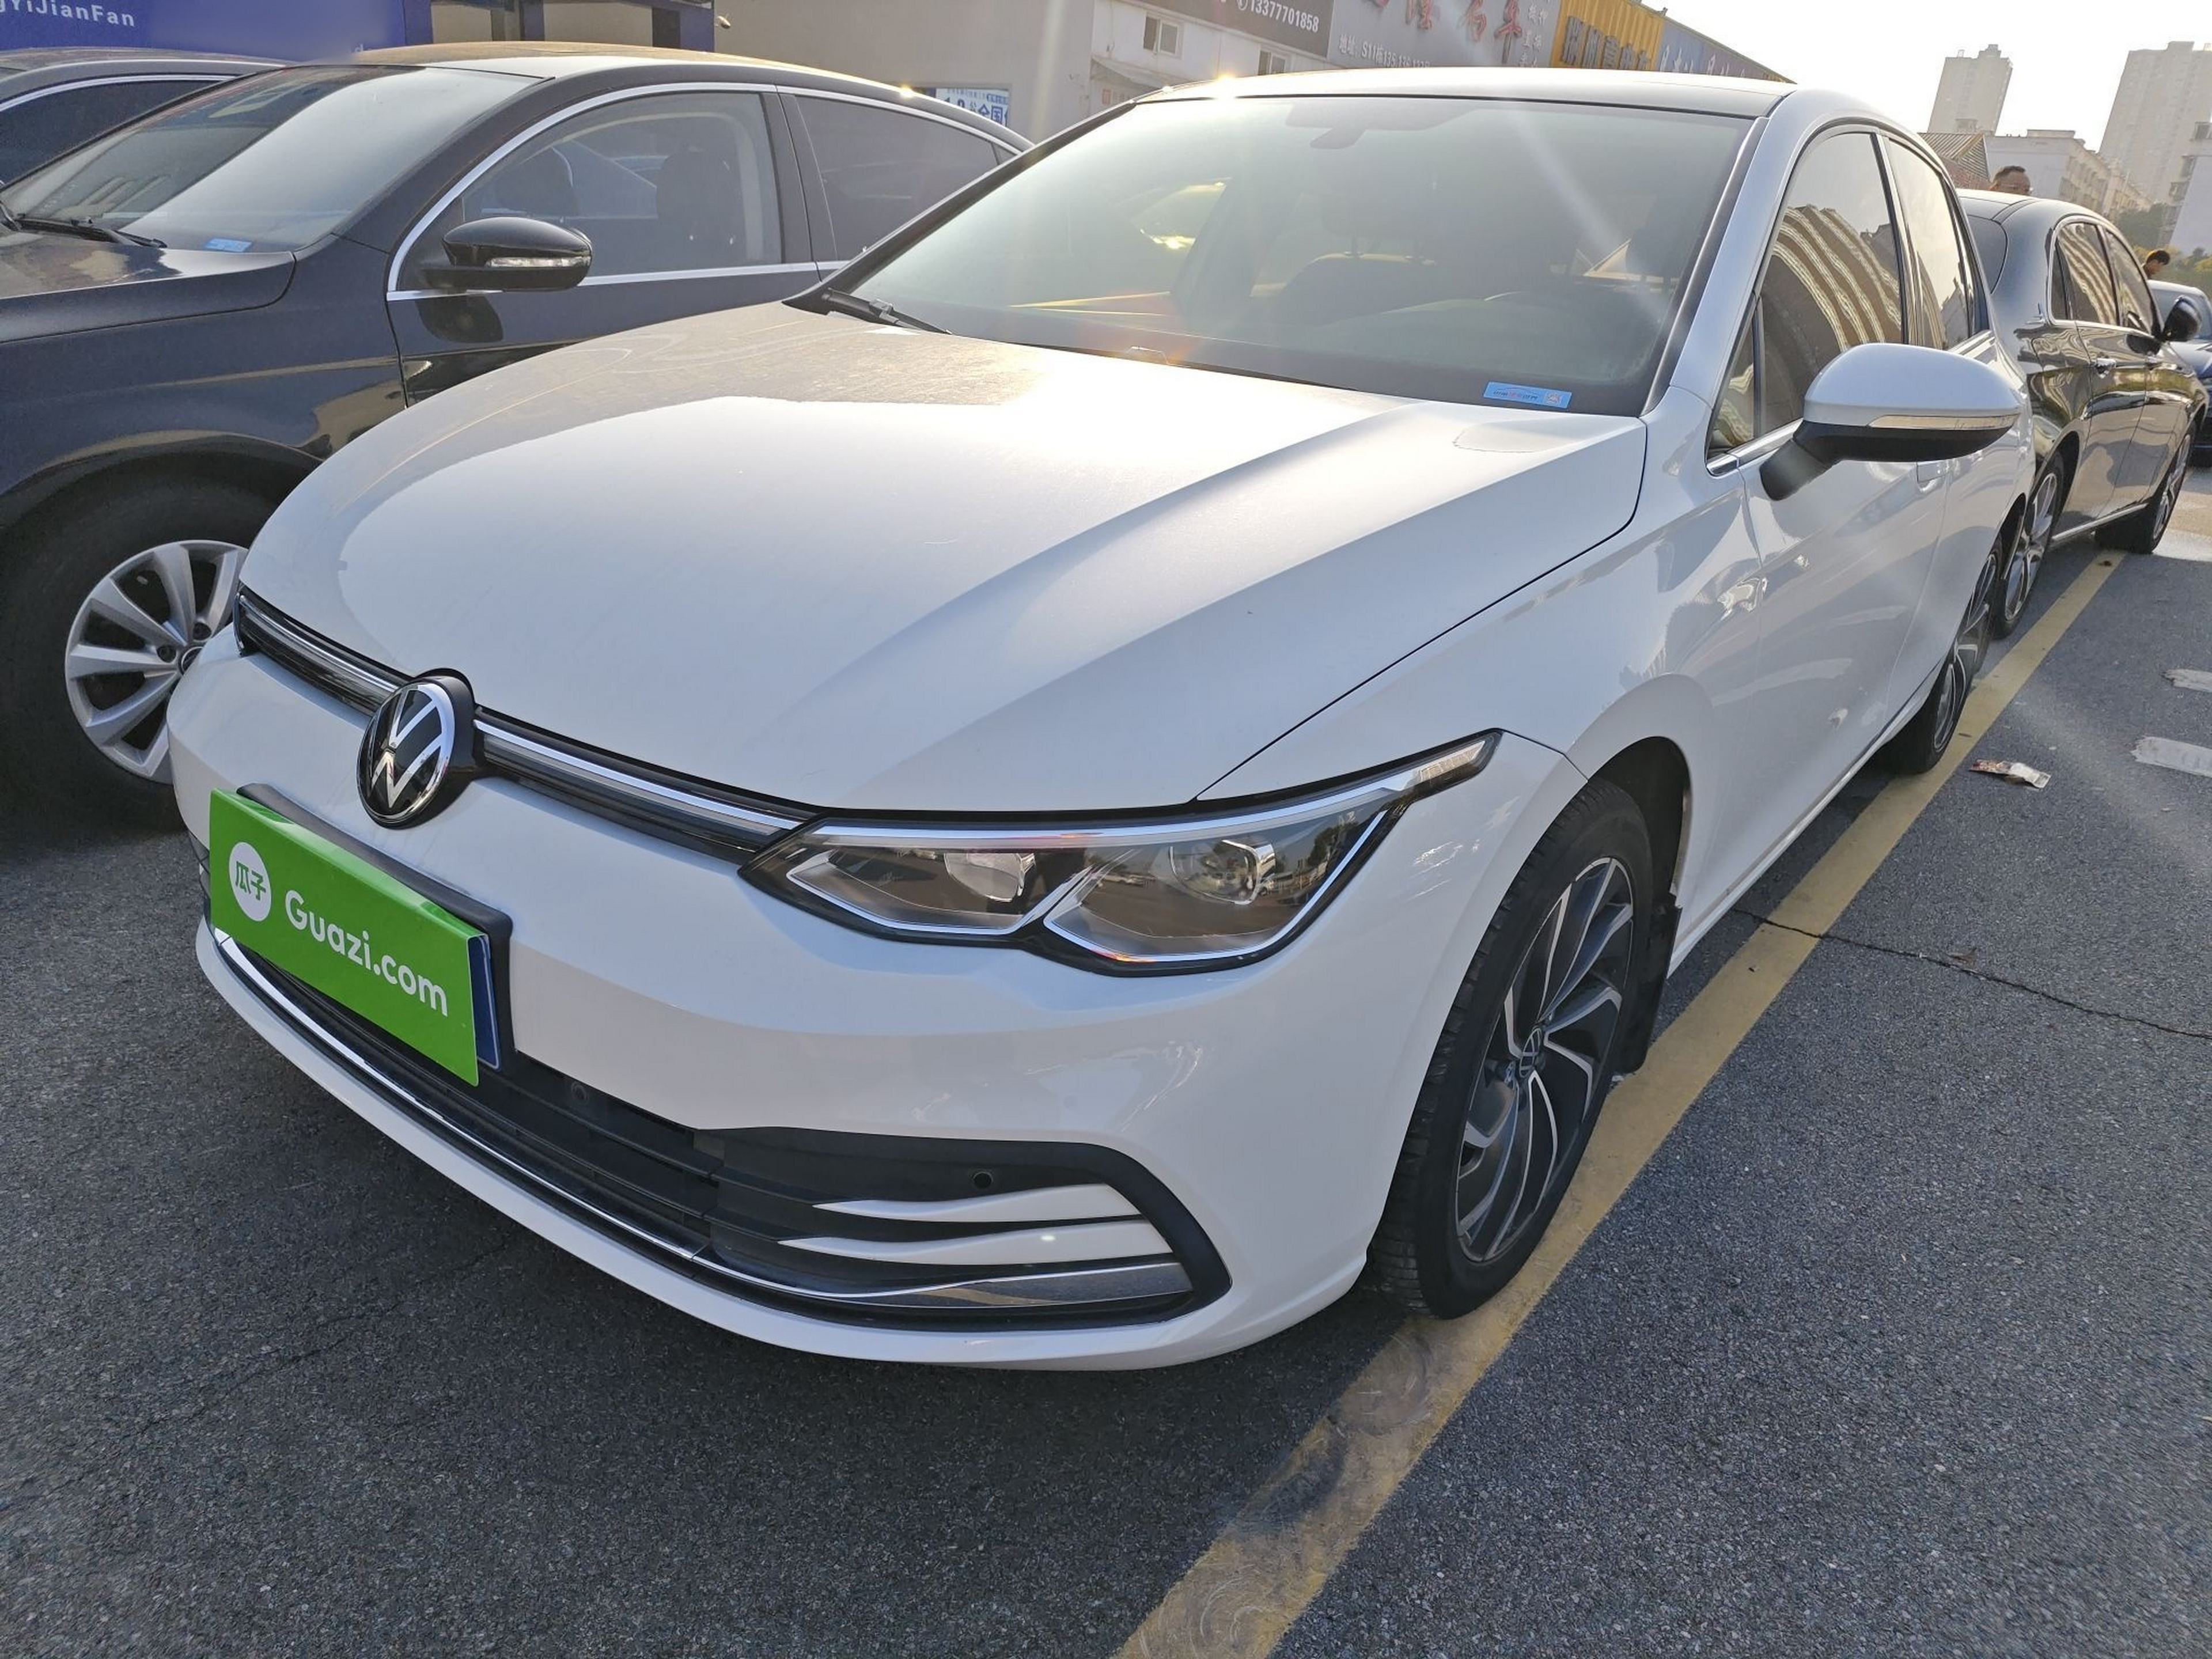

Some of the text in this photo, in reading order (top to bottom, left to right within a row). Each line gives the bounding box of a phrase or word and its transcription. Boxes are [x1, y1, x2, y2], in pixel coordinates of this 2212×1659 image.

[1251, 0, 1319, 33] 13377701858
[234, 861, 267, 901] 瓜子
[285, 890, 448, 1017] Guazi.com
